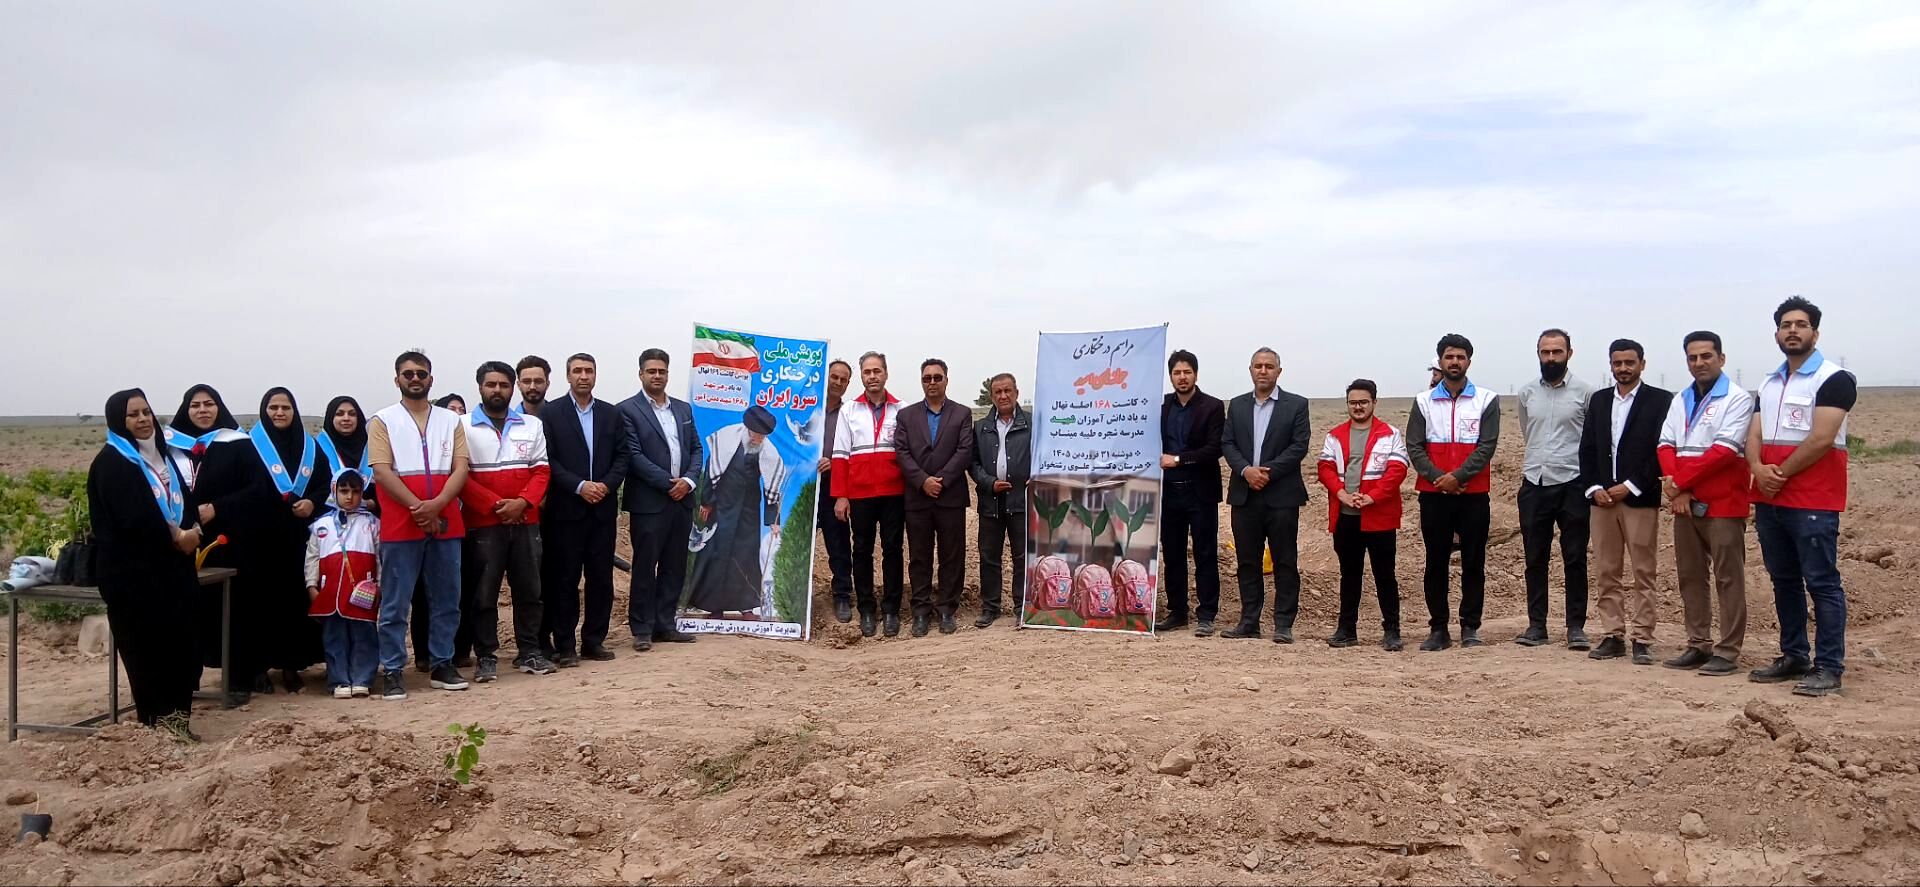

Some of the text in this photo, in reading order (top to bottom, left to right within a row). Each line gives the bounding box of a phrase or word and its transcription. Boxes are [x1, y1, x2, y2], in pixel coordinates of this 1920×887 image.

[764, 341, 822, 366] پویش ملی
[1110, 338, 1134, 367] مراسم
[756, 386, 818, 409] سرو ایران
[1052, 401, 1068, 410] نهال
[1095, 400, 1110, 409] ۱۶۸
[1112, 398, 1138, 408] کاشت
[1078, 414, 1105, 425] آموزان
[1106, 414, 1126, 424] دانش
[1128, 413, 1138, 422] یاد
[1050, 429, 1077, 439] میناب
[1098, 429, 1118, 439] شجره
[1120, 429, 1144, 439] مدرسه
[1072, 450, 1099, 460] فروردین
[1112, 451, 1133, 459] دوشنبه
[1092, 463, 1116, 471] دکتر
[1118, 463, 1143, 471] هنرستان
